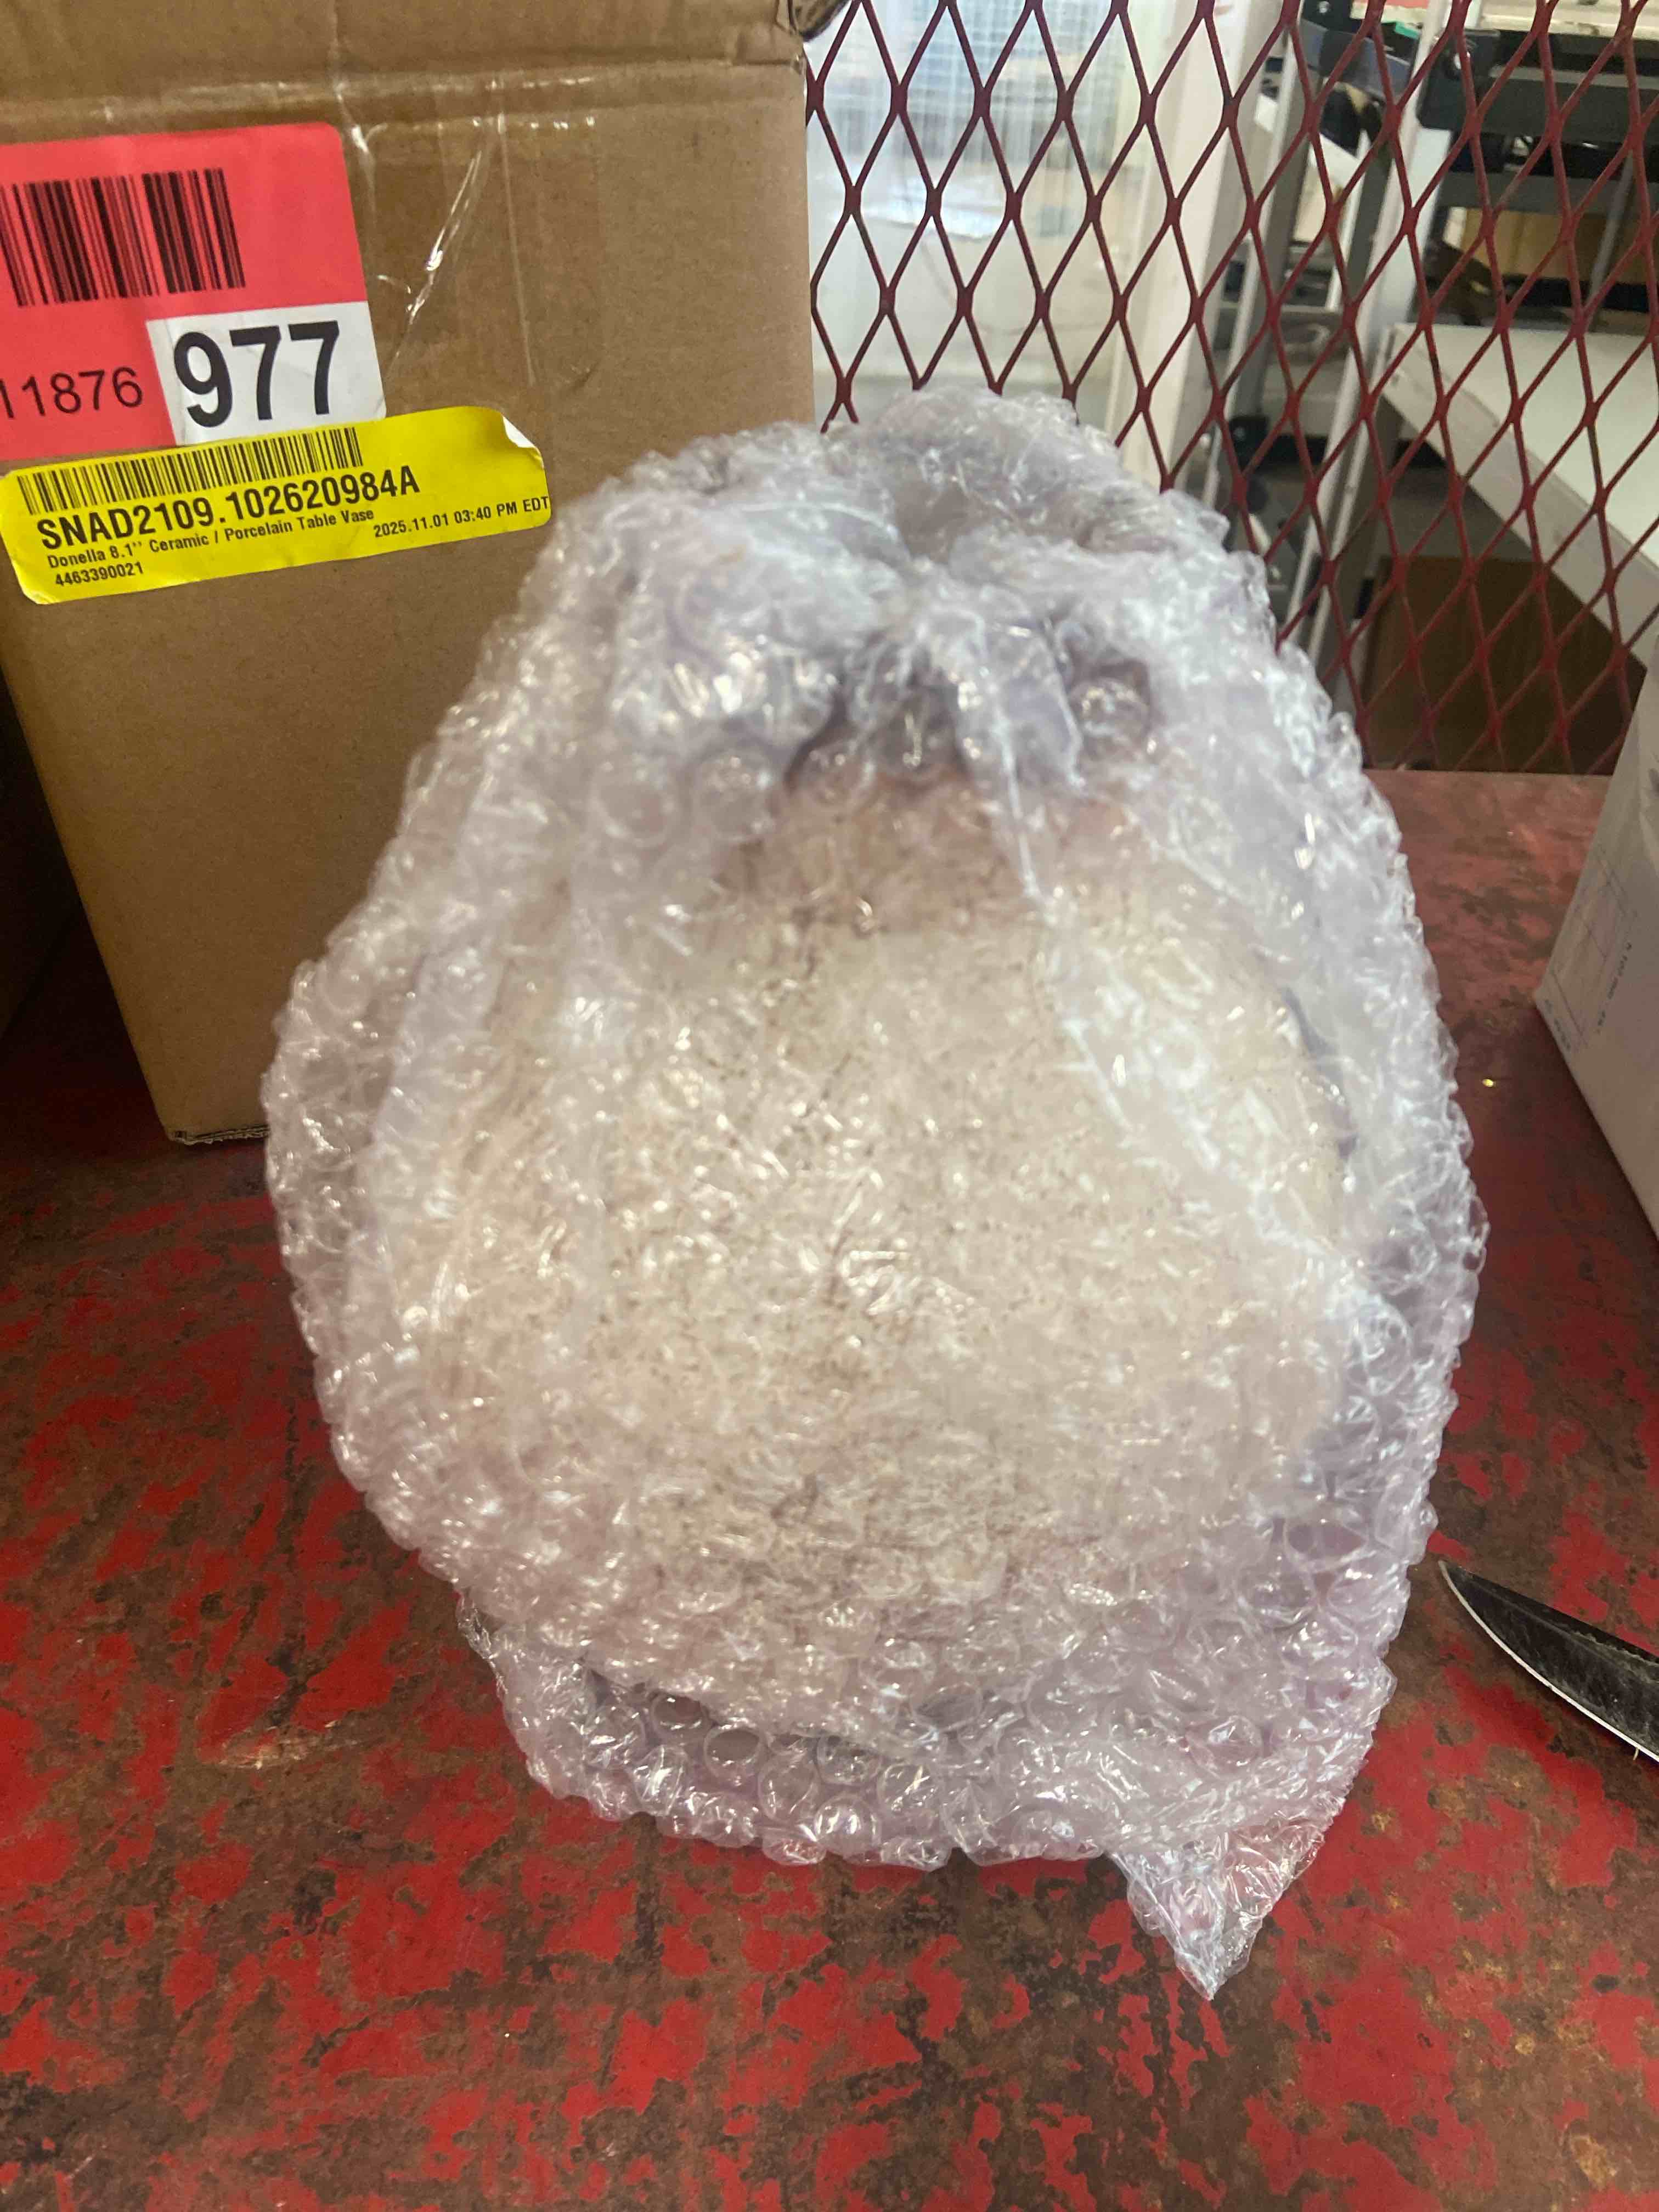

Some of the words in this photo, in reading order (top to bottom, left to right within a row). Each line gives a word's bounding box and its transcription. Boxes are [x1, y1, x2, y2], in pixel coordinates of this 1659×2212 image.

[174, 320, 339, 428] 977
[37, 465, 420, 550] SNAD2109.102620984A
[373, 513, 450, 538] 2025.11.01
[454, 506, 492, 523] 03:40
[496, 501, 518, 517] PM
[522, 496, 549, 512] EDT
[47, 549, 106, 568] Donella
[149, 533, 209, 552] Ceramic
[224, 520, 293, 541] Porcelain
[297, 513, 336, 530] Table
[340, 509, 374, 523] Vase
[55, 561, 143, 586] 4463390021
